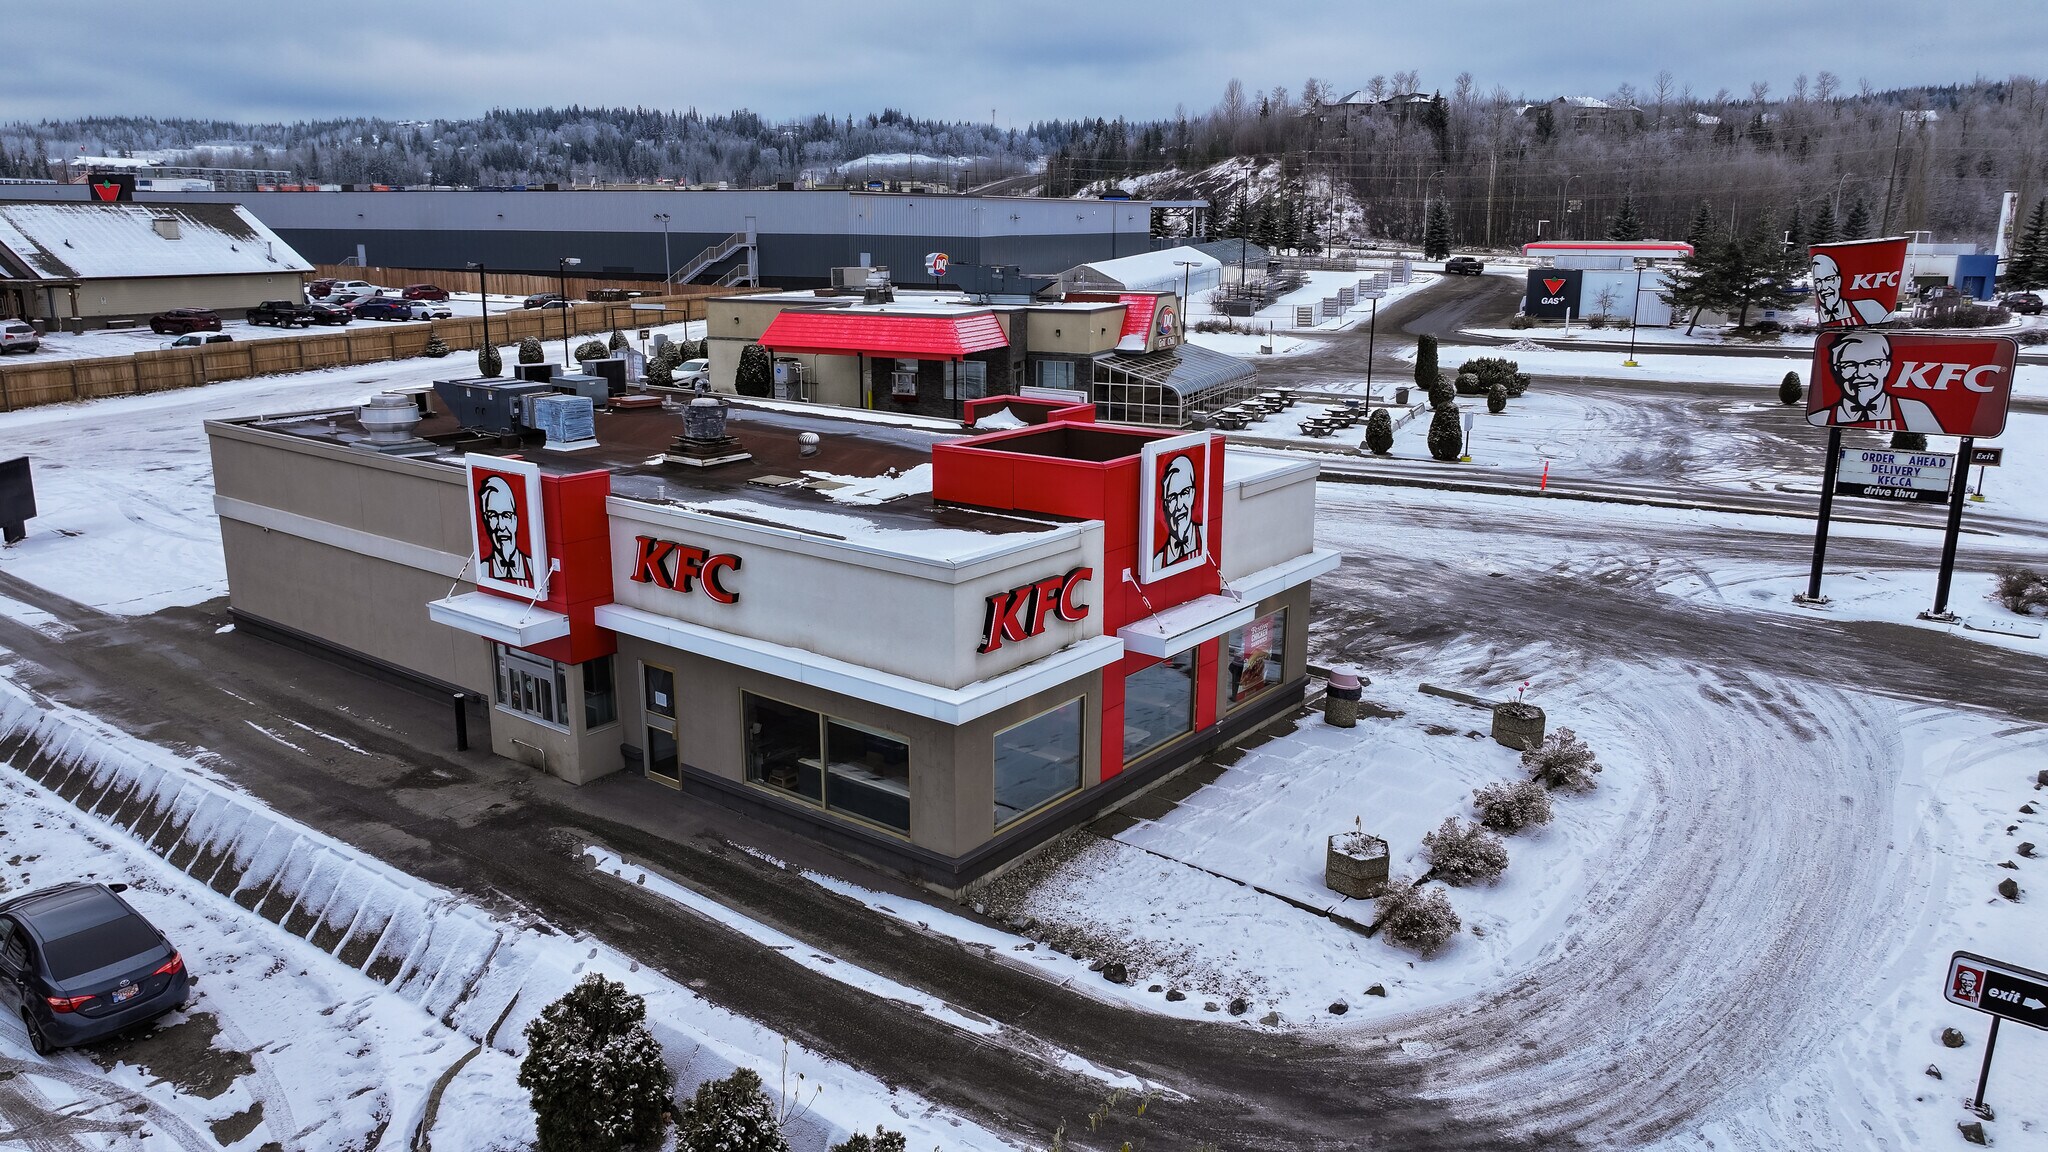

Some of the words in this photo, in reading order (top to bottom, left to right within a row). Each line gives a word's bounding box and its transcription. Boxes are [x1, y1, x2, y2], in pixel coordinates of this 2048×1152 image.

[1850, 270, 1900, 291] KFC
[1861, 452, 1895, 464] ORDER
[1908, 456, 1946, 467] AHEAD
[1975, 452, 1995, 460] Exit
[1871, 464, 1921, 477] DELIVERY
[1877, 475, 1912, 487] KFC.CA
[1863, 486, 1891, 497] drive
[1893, 488, 1918, 499] thru
[630, 535, 742, 604] KFC
[976, 567, 1093, 654] KFC
[1988, 987, 2021, 1004] exit
